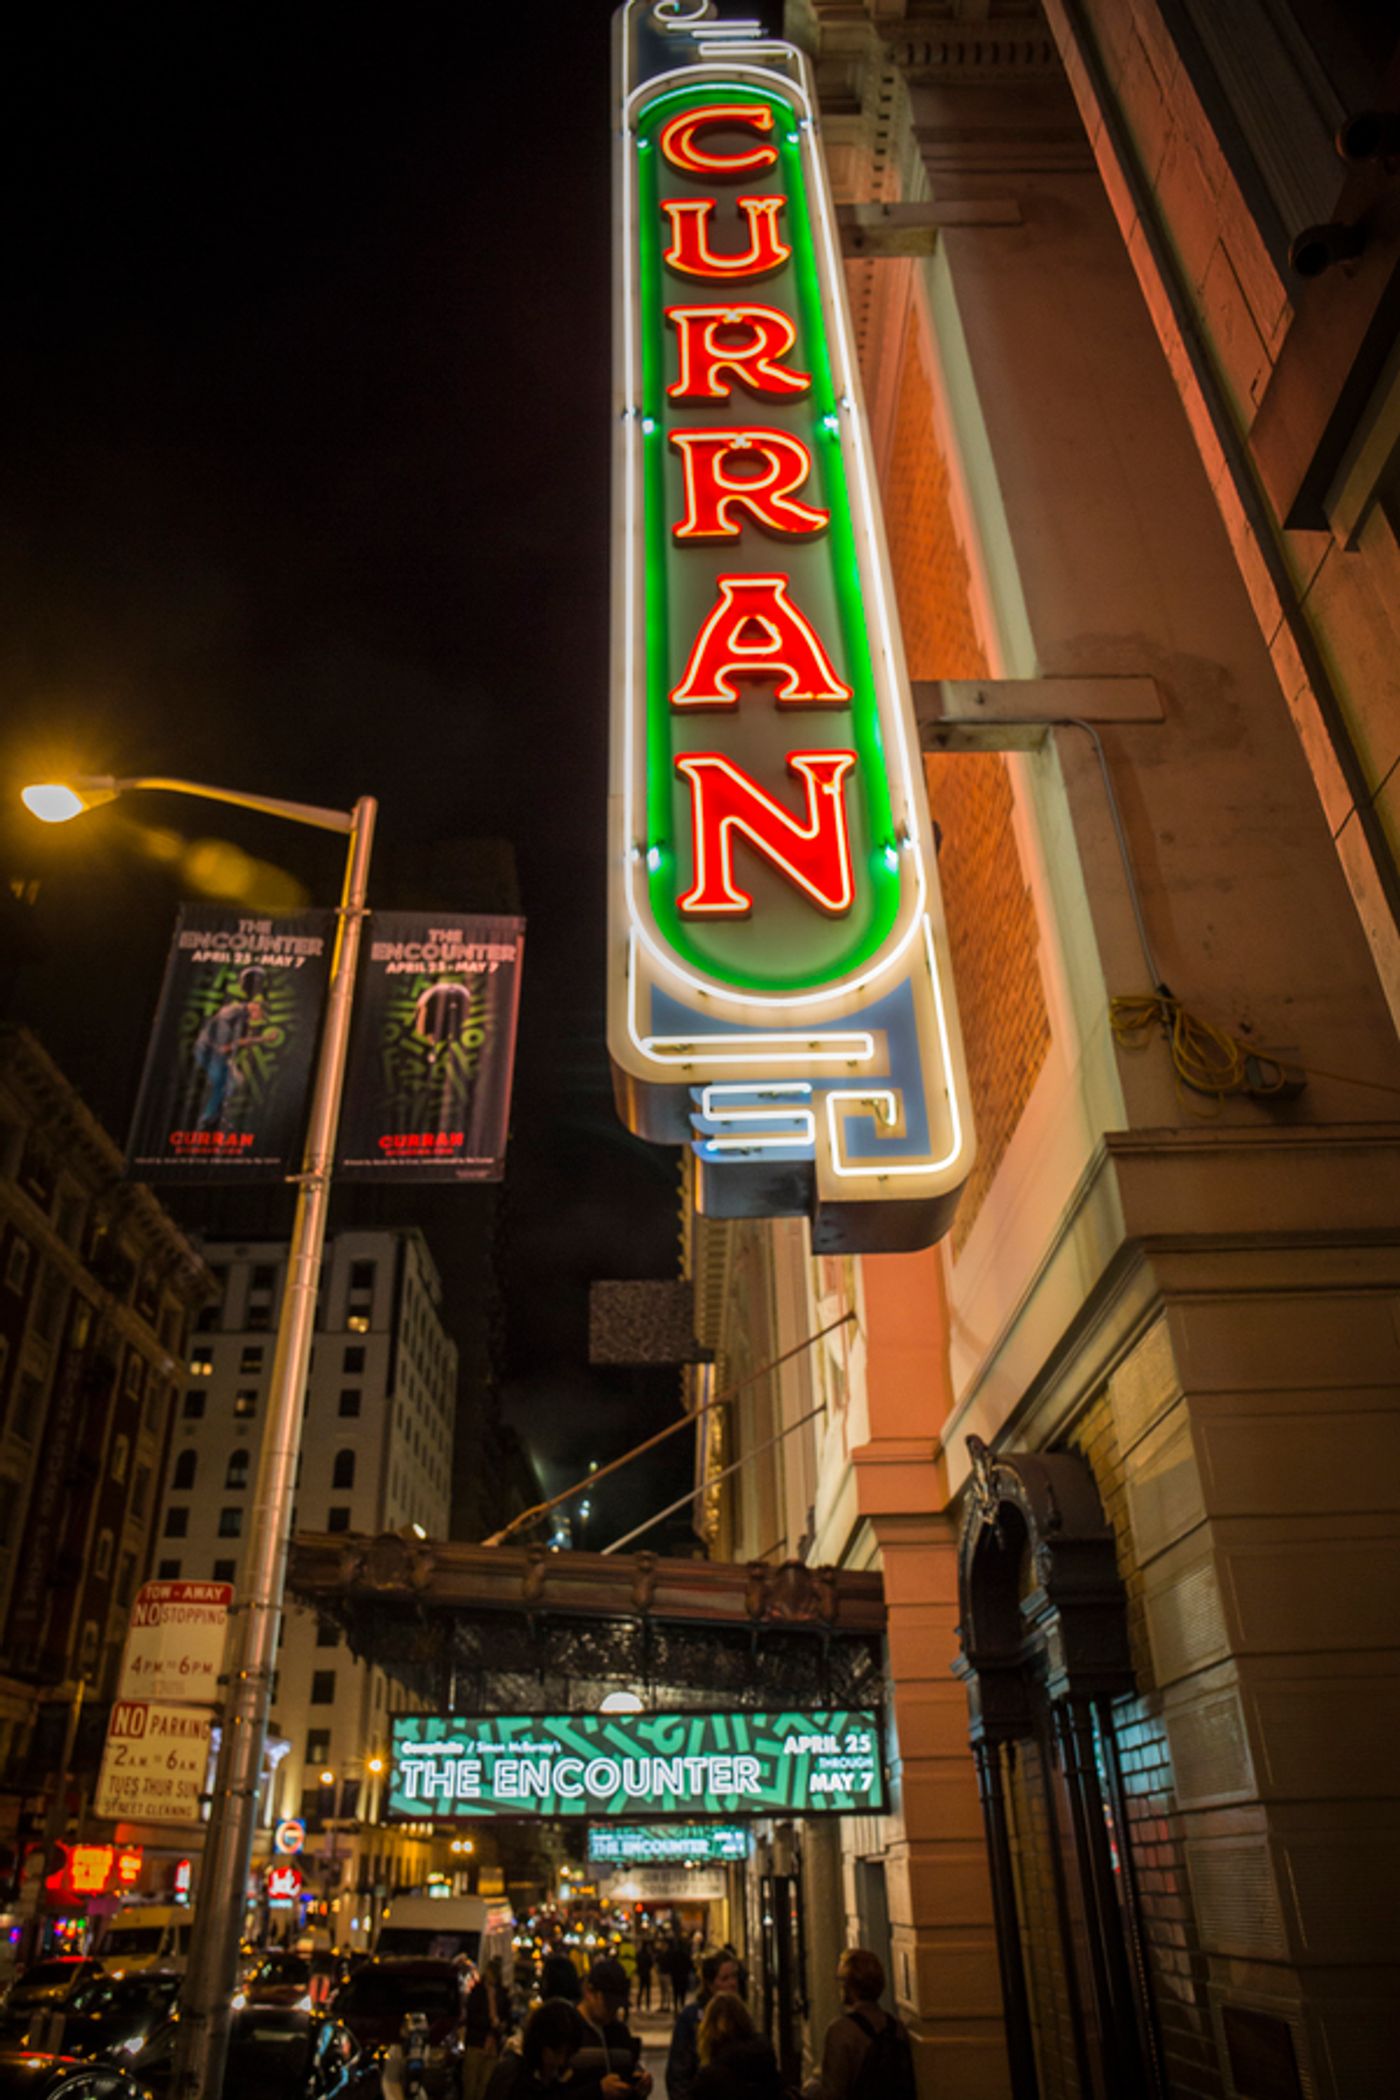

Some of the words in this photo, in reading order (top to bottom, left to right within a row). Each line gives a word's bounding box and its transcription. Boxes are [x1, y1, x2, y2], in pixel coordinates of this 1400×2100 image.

[660, 103, 856, 916] CURRAN
[238, 919, 273, 934] THE
[428, 928, 463, 943] THE
[178, 931, 324, 956] ENCOUNTER
[371, 942, 517, 961] ENCOUNTER
[191, 950, 230, 963] APRIL
[261, 954, 290, 967] MAY
[294, 956, 306, 968] 7
[385, 962, 426, 975] APRIL
[455, 961, 487, 973] MAY
[488, 962, 499, 975] 7
[169, 1131, 255, 1147] CURRAN
[378, 1131, 464, 1148] CURRAN
[145, 1586, 170, 1599] TOW
[183, 1586, 225, 1599] AWAY
[133, 1603, 159, 1626] NO
[161, 1607, 226, 1626] STOPPING
[112, 1705, 146, 1736] NO
[150, 1714, 211, 1739] PARKING
[783, 1735, 841, 1754] APRIL
[845, 1734, 871, 1753] 25
[819, 1757, 873, 1770] THROUGH
[109, 1775, 139, 1795] TUES
[142, 1776, 173, 1796] THUR
[176, 1778, 201, 1798] SUN
[400, 1759, 482, 1799] THE
[494, 1756, 762, 1799] ENCOUNTER
[809, 1773, 854, 1793] MAY
[861, 1772, 874, 1791] 7
[103, 1798, 142, 1814] STREET
[145, 1800, 193, 1817] CLEANING
[622, 1839, 709, 1854] ENCOUNTER
